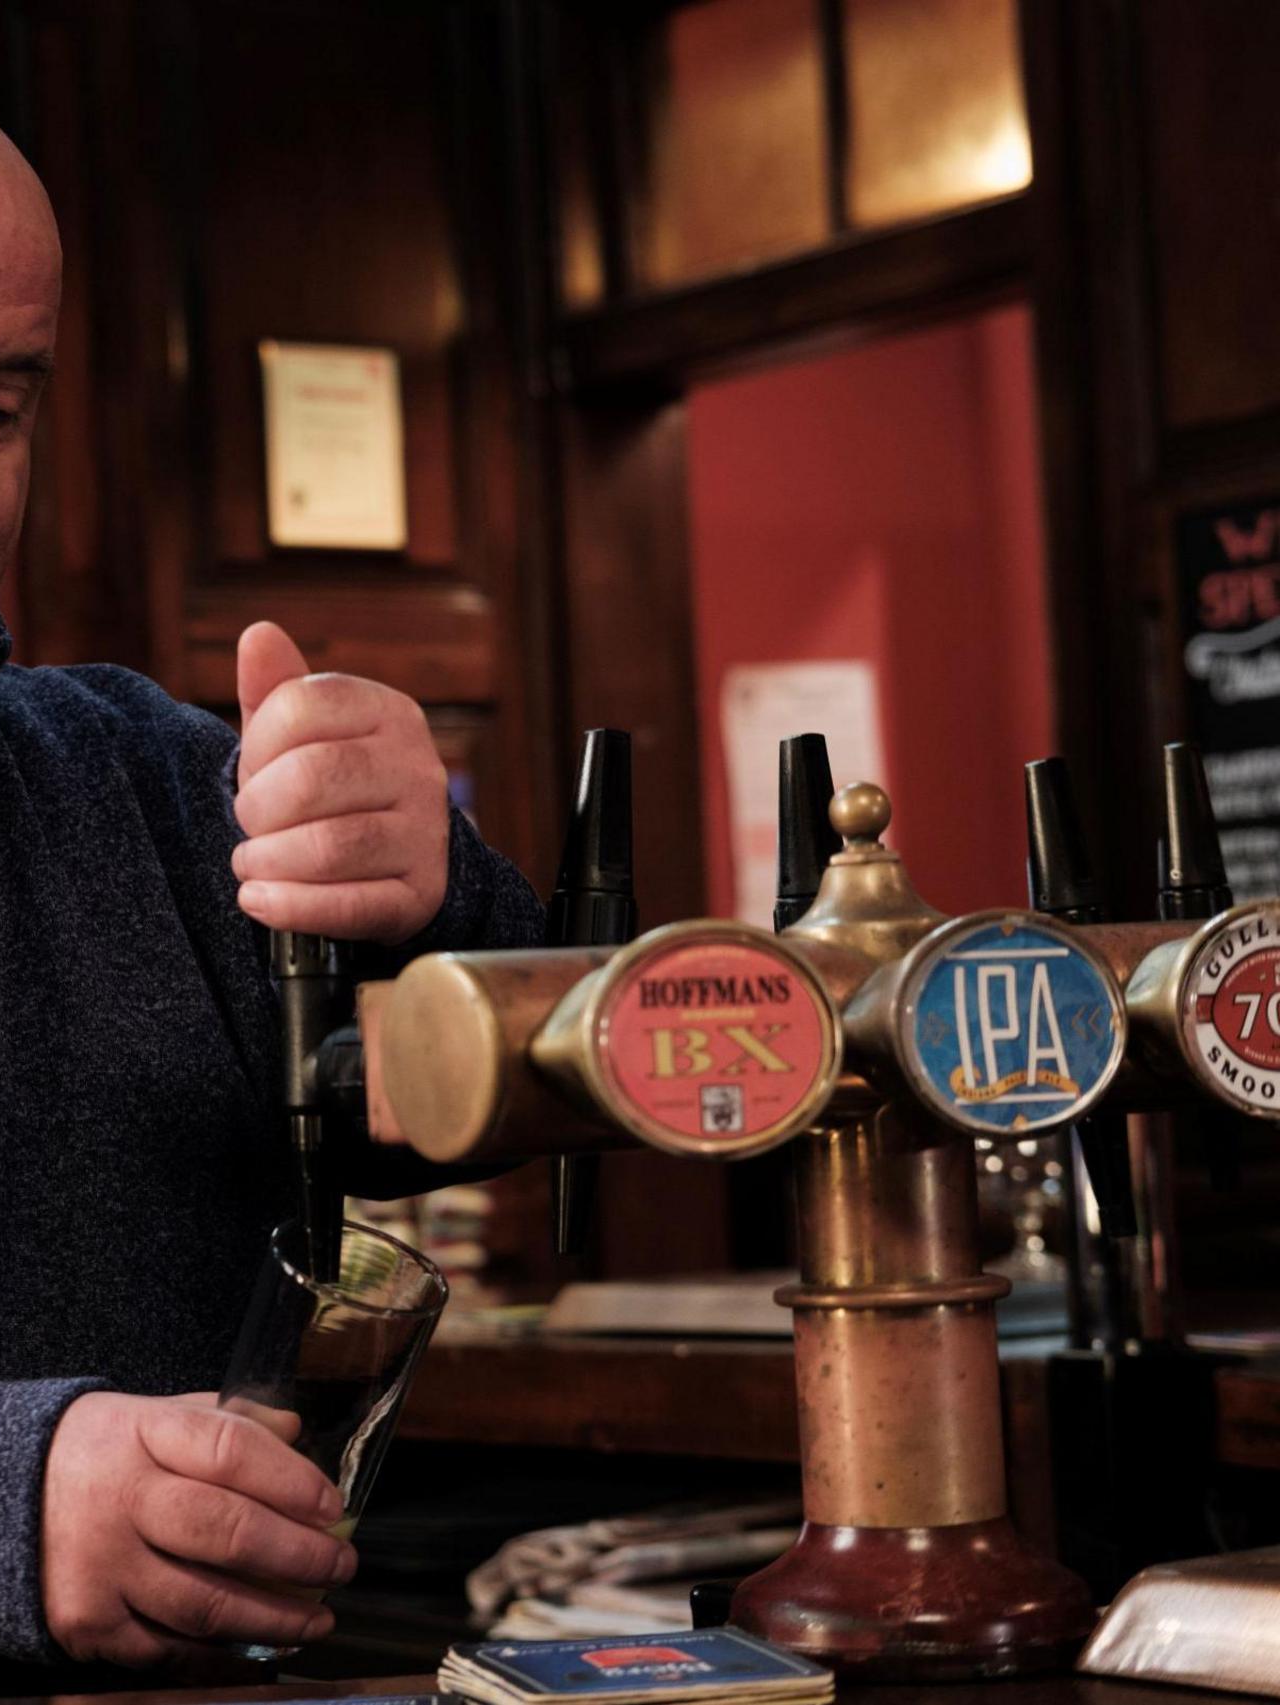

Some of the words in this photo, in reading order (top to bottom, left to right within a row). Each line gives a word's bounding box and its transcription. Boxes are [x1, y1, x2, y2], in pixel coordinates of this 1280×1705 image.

[1206, 919, 1280, 979] GULL
[639, 975, 791, 1009] HOFFMANS
[645, 1023, 796, 1080] BX
[954, 963, 1071, 1087] IPA
